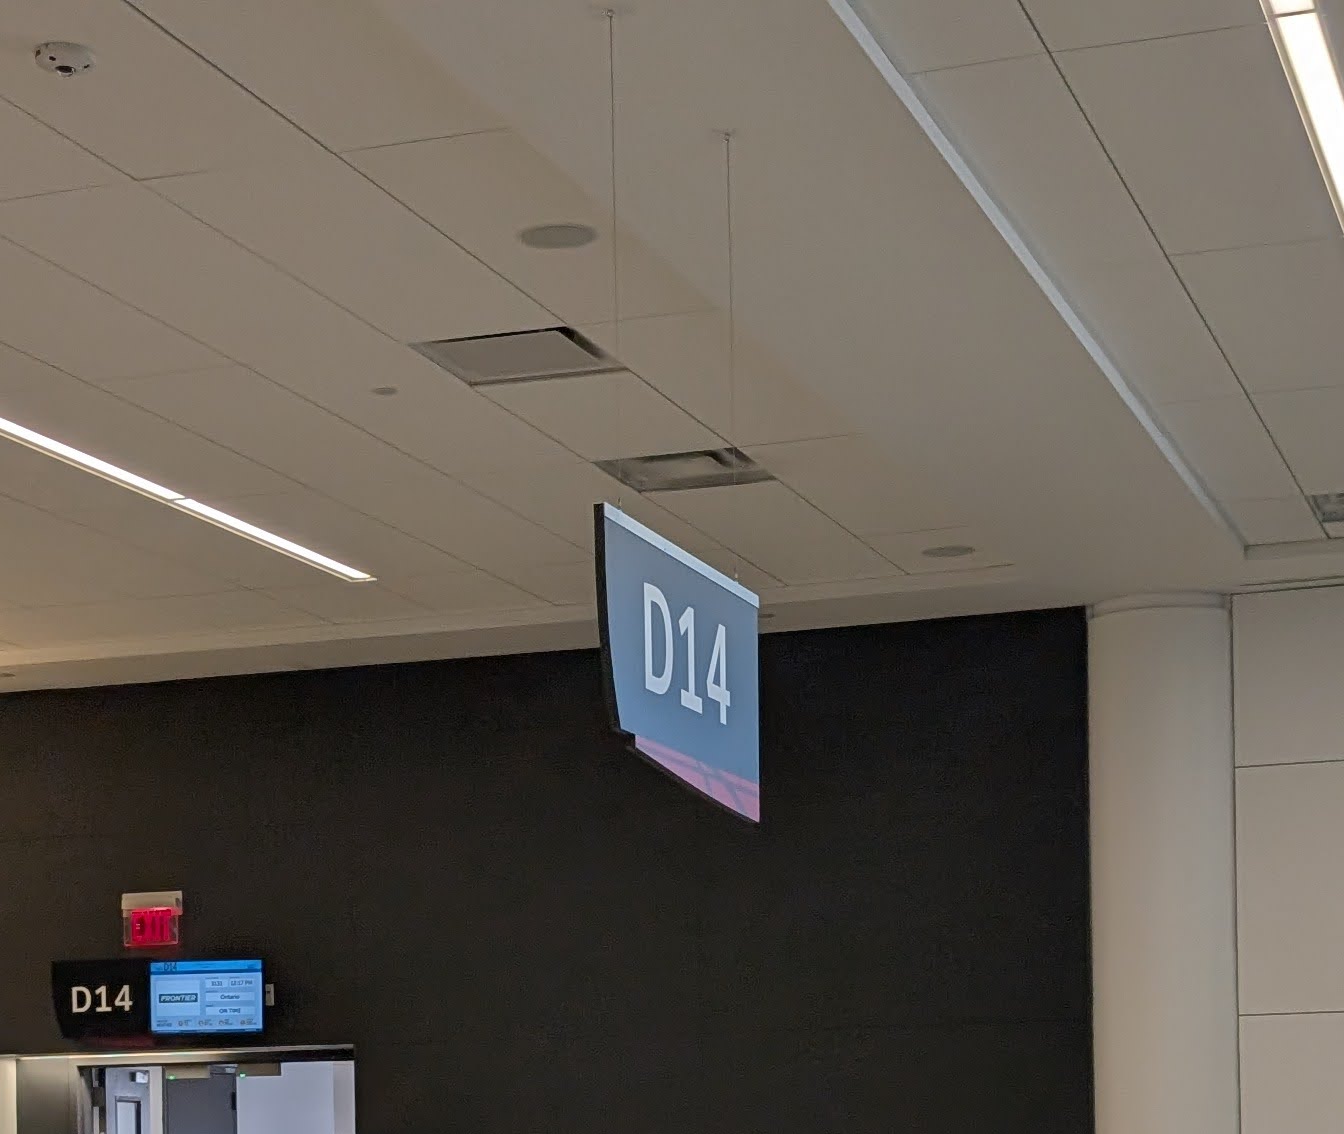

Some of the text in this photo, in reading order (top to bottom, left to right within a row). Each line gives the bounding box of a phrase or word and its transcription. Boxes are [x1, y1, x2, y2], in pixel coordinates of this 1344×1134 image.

[643, 582, 731, 726] D14
[132, 908, 171, 942] EXIT
[71, 984, 134, 1014] D14
[160, 994, 197, 1003] FRONTIER
